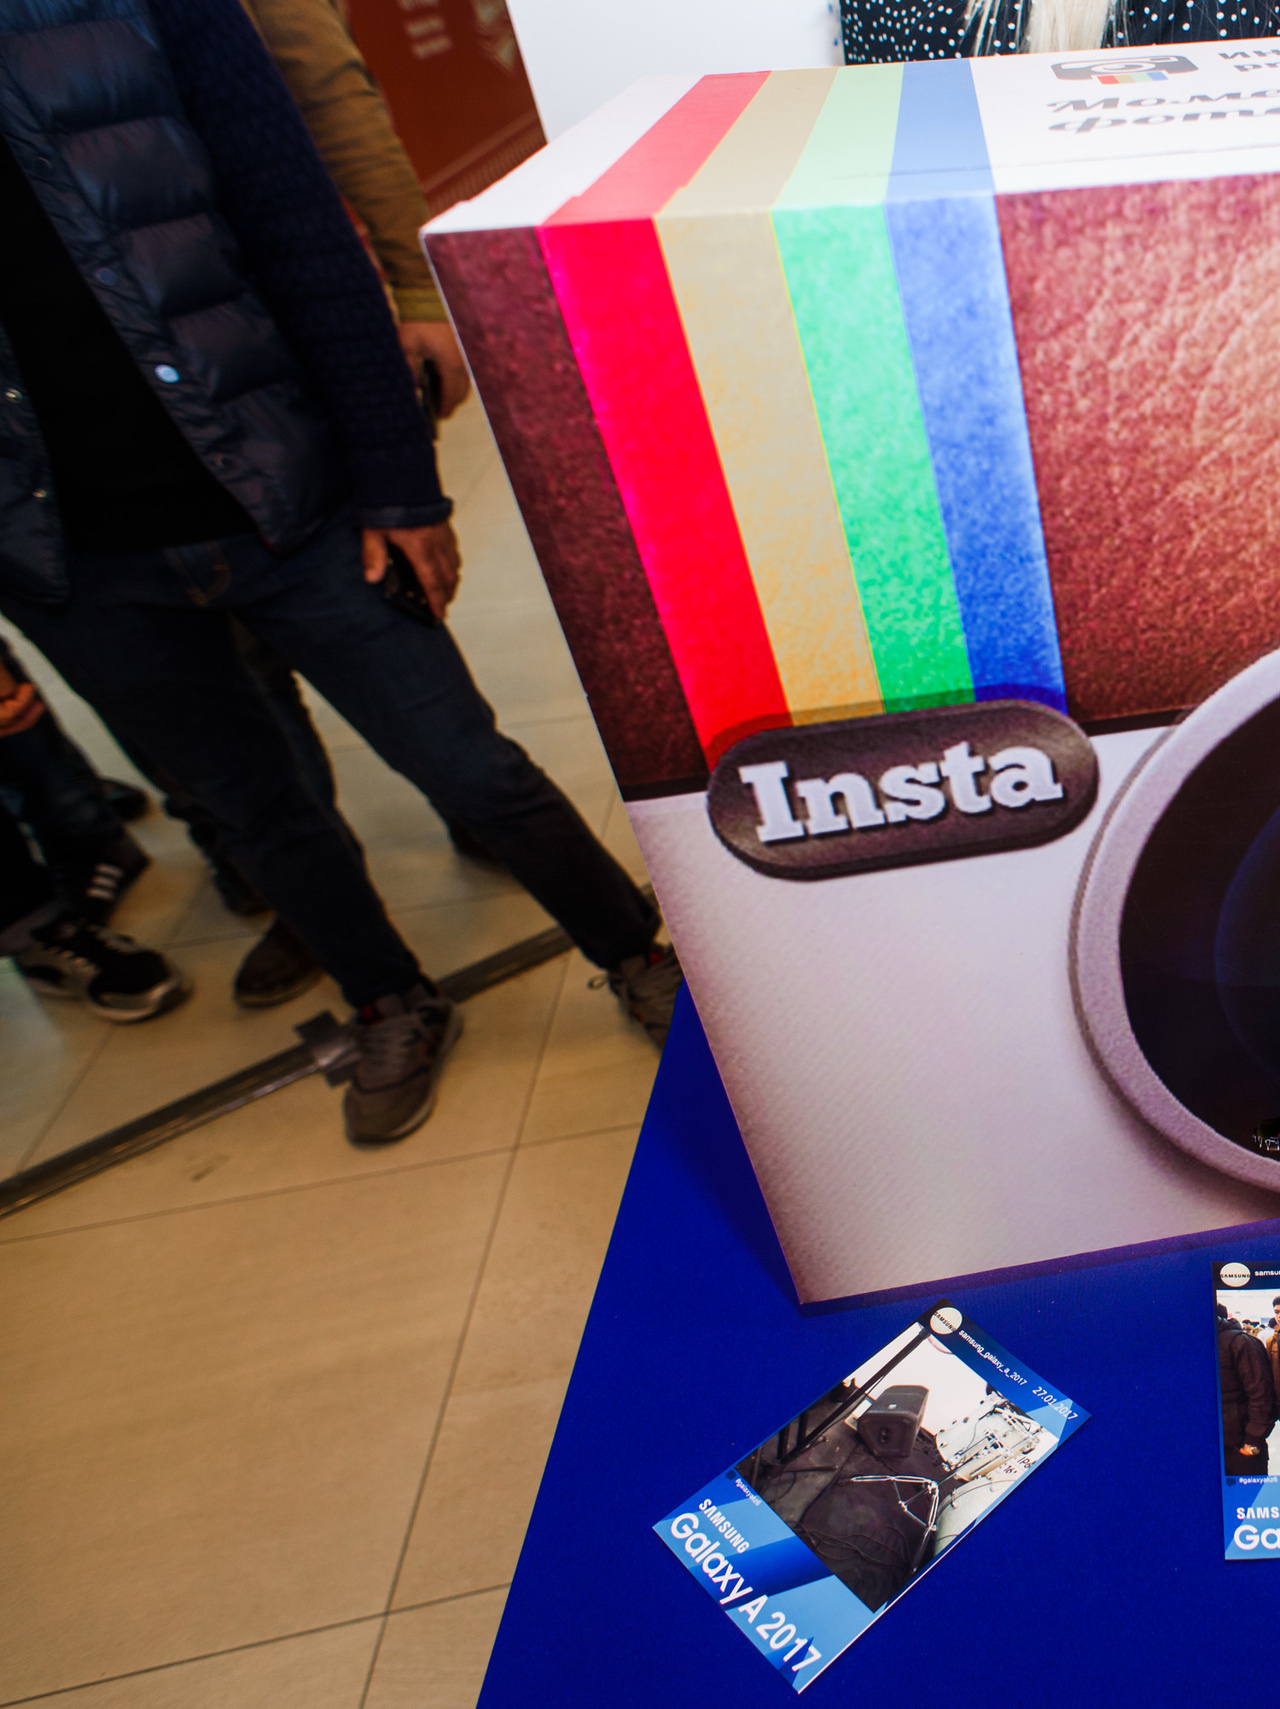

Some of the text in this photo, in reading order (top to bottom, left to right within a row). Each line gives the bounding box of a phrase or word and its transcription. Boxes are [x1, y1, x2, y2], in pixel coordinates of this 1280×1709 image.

[738, 741, 1064, 843] Insta
[958, 1330, 1078, 1421] samsung_galaxy_a_2017 27.01.2017
[698, 1498, 751, 1554] SAMSUNG
[670, 1512, 822, 1672] Galaxy A 2017
